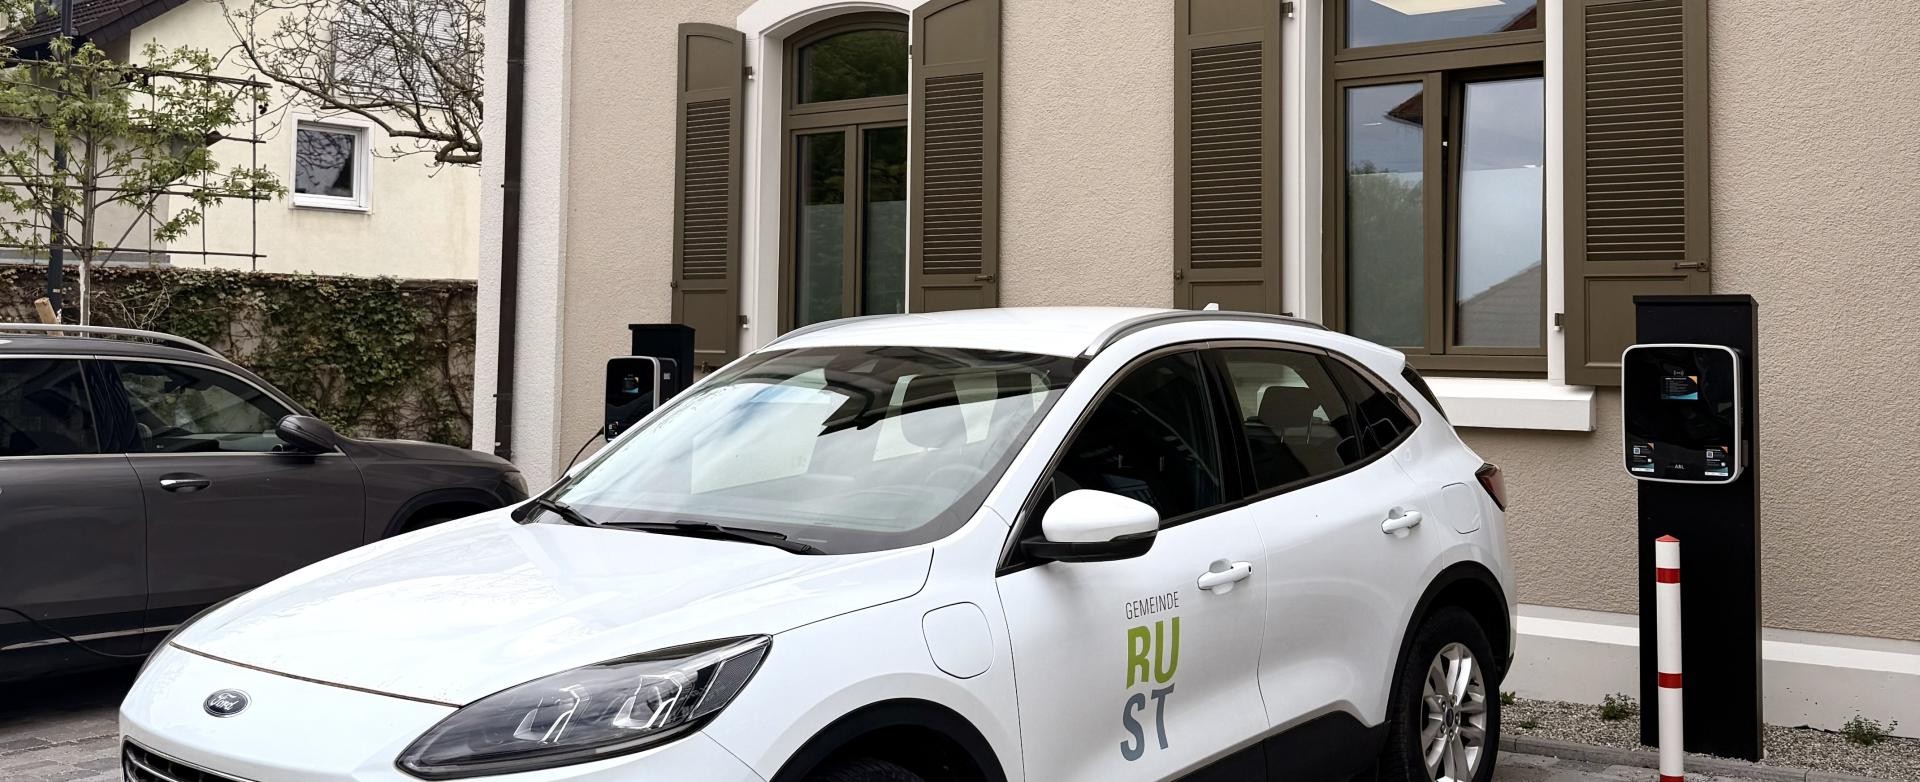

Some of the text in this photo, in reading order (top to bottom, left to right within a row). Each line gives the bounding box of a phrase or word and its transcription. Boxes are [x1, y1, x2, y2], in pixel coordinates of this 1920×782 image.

[1125, 591, 1179, 620] GEMEINDE
[1126, 616, 1180, 689] RU
[210, 692, 239, 711] Ford
[1120, 683, 1175, 762] ST
